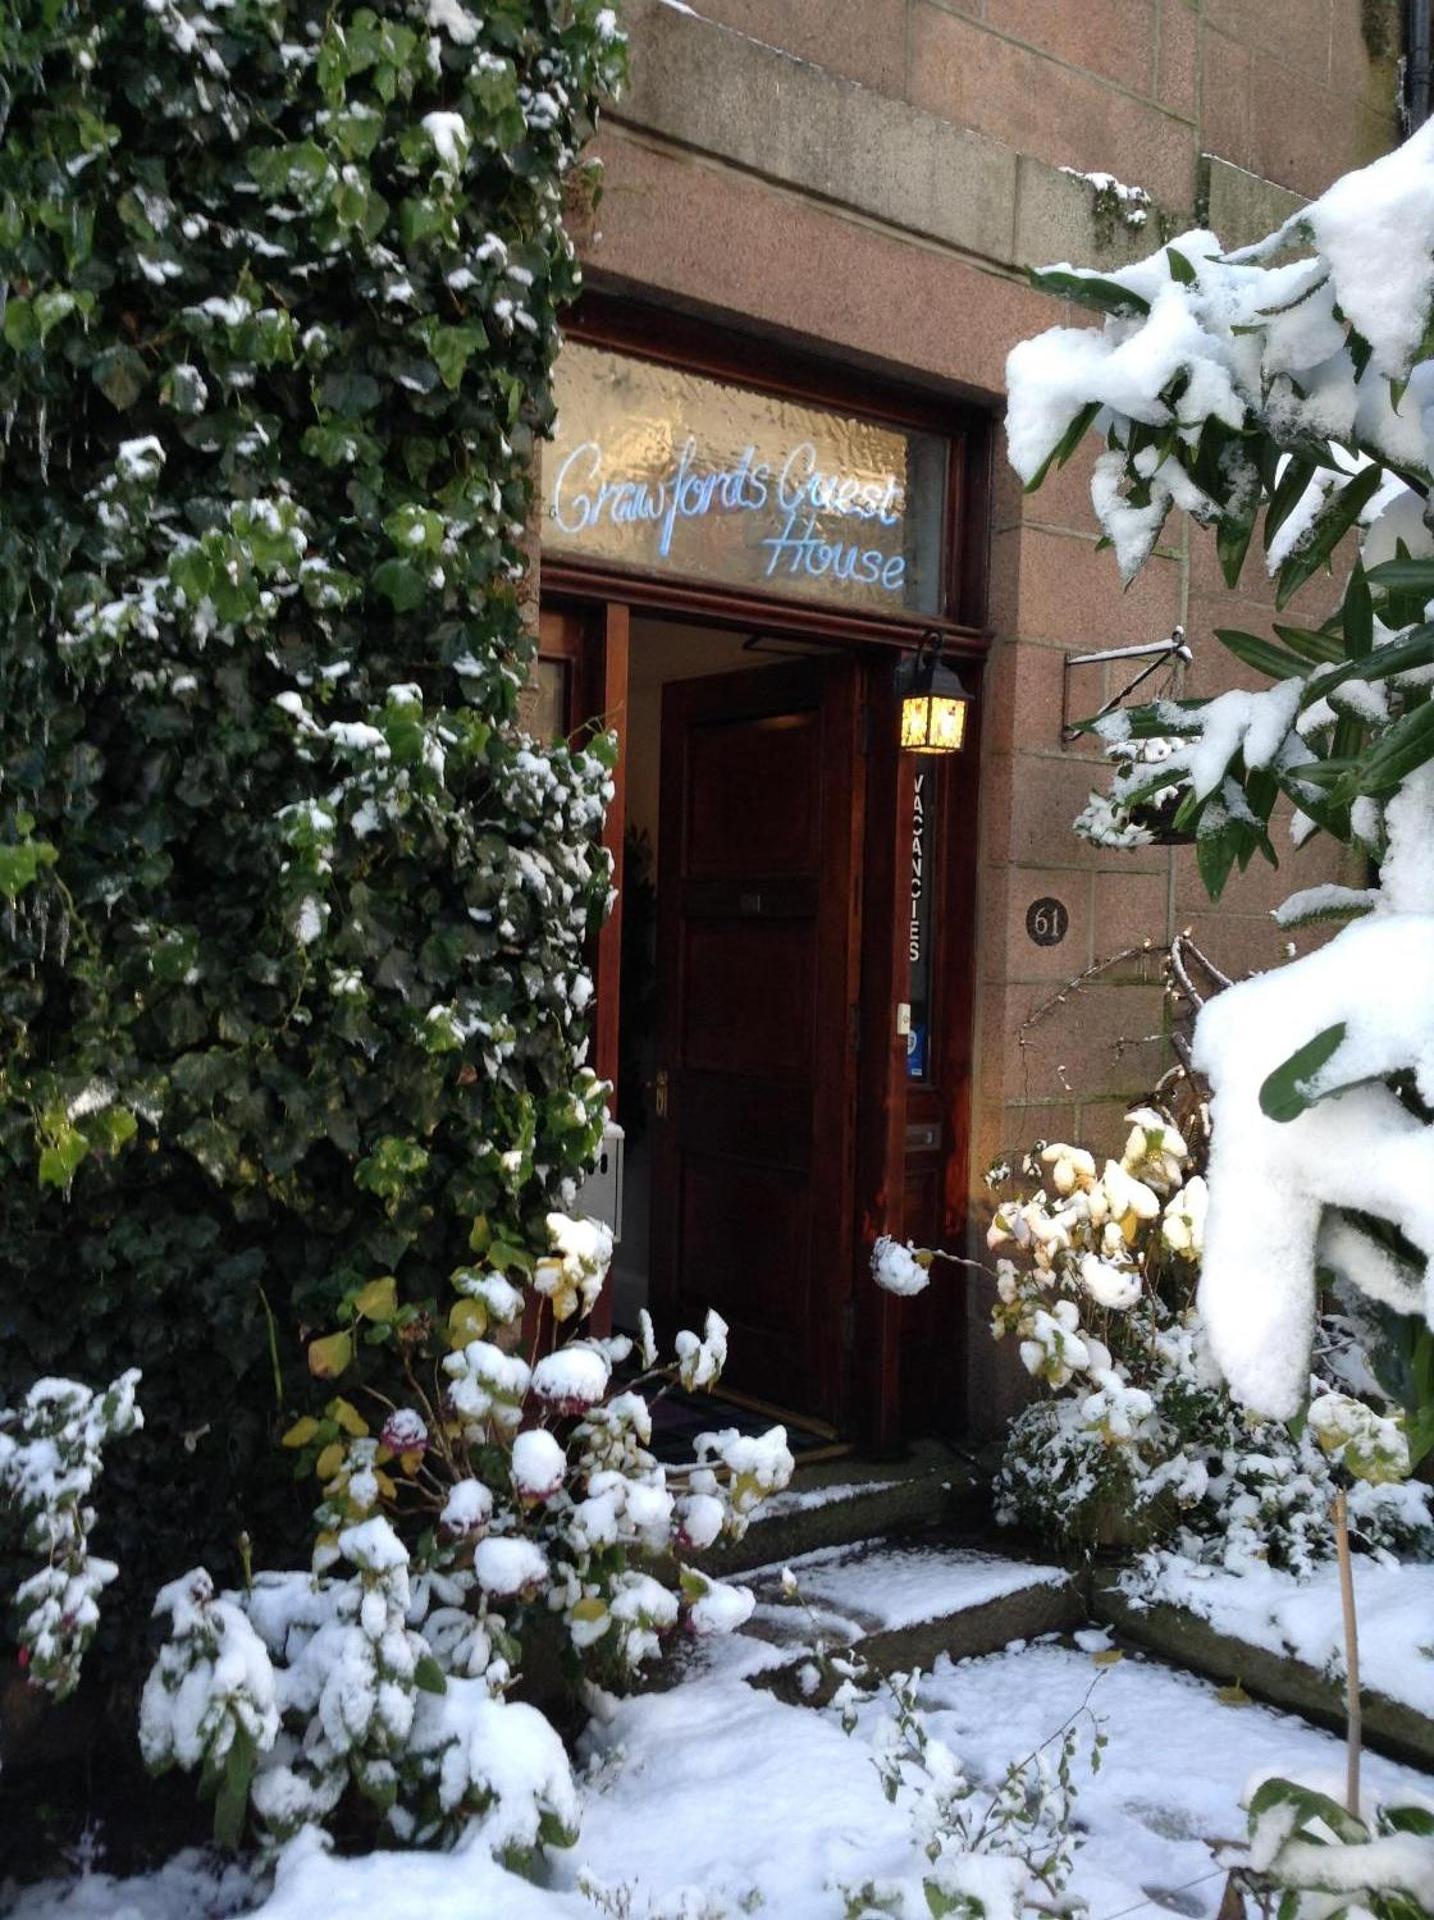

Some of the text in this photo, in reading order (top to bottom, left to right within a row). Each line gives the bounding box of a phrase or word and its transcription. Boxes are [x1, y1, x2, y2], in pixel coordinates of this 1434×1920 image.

[554, 435, 906, 558] Crawfords Guest
[762, 513, 906, 589] House
[909, 774, 924, 962] VACANCIES
[1035, 908, 1059, 936] 61
